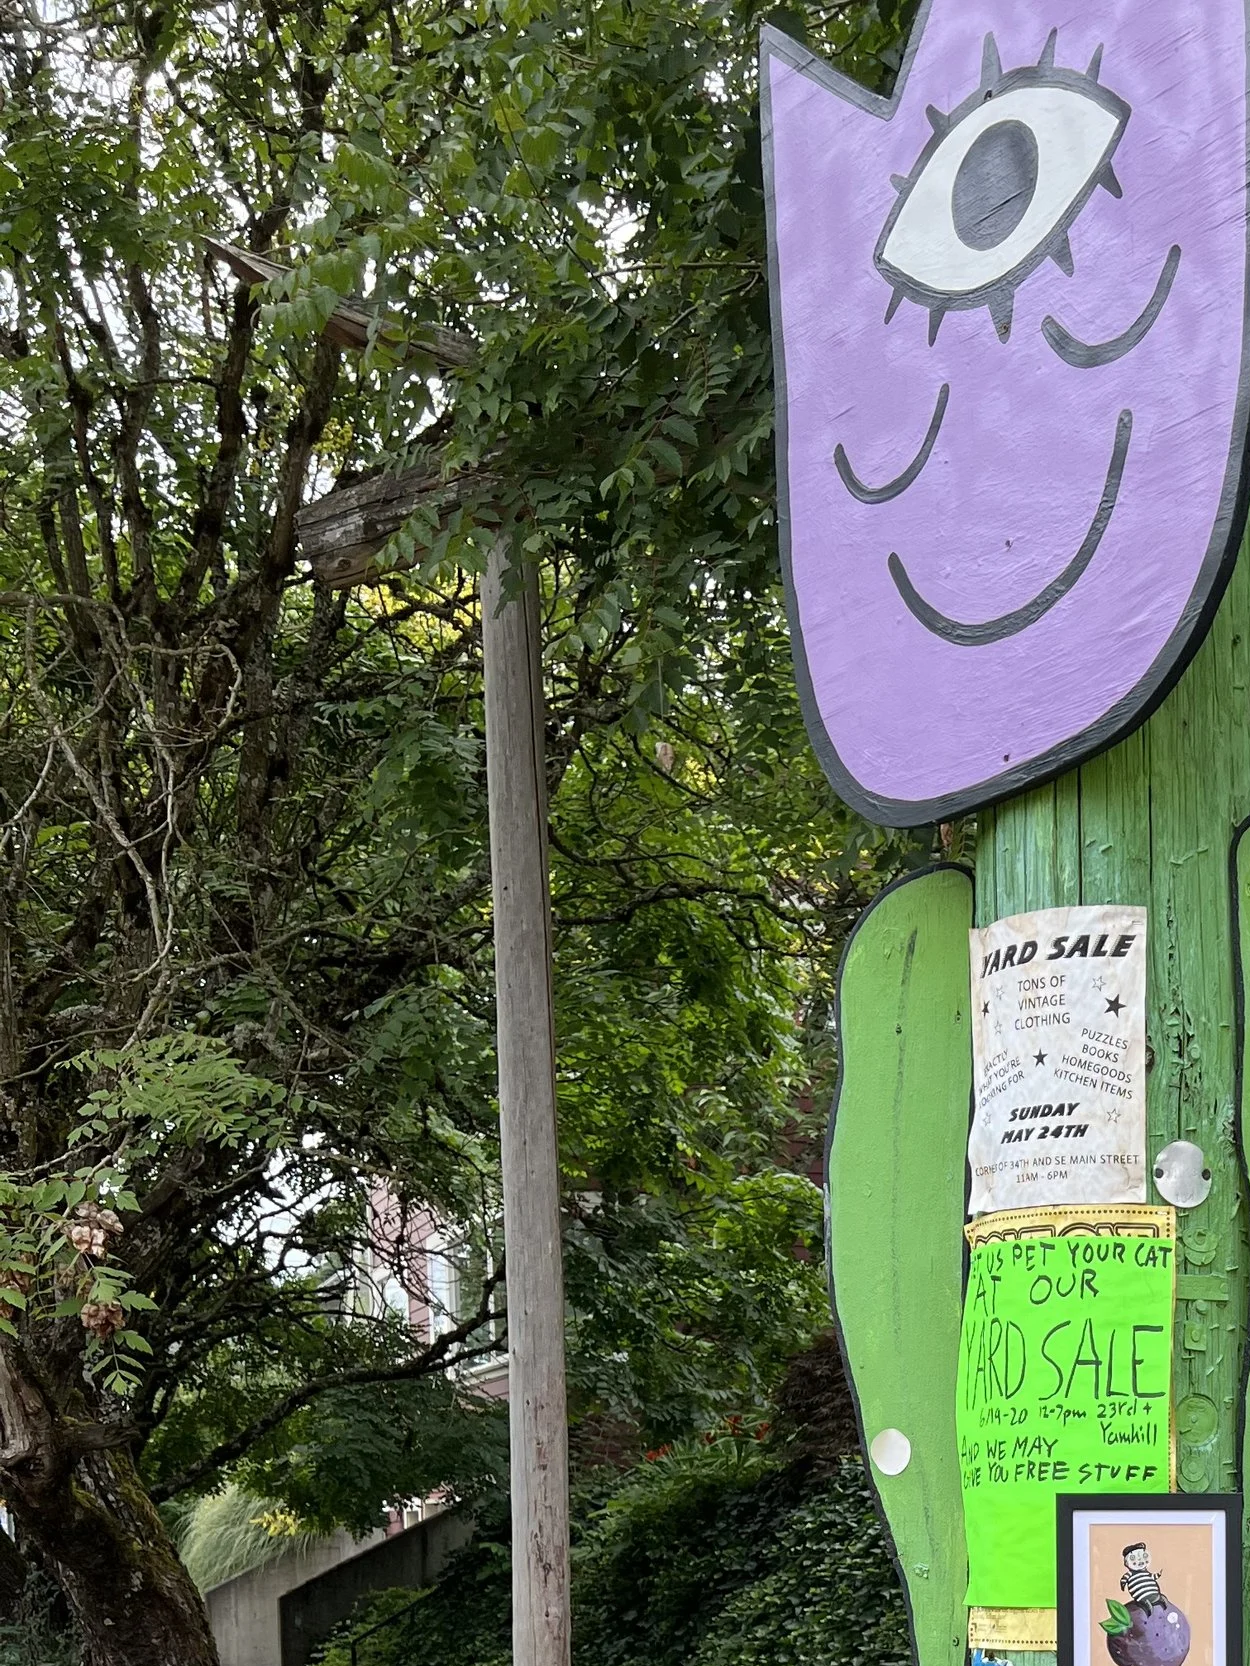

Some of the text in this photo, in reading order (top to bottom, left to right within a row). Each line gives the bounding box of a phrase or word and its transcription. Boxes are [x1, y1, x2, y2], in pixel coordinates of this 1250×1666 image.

[980, 934, 1136, 978] YARD SALE
[1018, 974, 1066, 992] TONS OF
[1018, 994, 1066, 1011] VINTAGE
[1014, 1012, 1071, 1031] CLOTHING
[1081, 1027, 1129, 1050] PUZZLES
[1082, 1044, 1119, 1063] BOOKS
[1008, 1070, 1024, 1085] FOR
[1061, 1054, 1132, 1084] HOMEGOODS
[1054, 1068, 1133, 1100] KITCHEN ITEMS
[1008, 1102, 1080, 1122] SUNDAY
[1000, 1124, 1090, 1144] MAY 24TH
[1032, 1156, 1052, 1166] AND
[1054, 1156, 1066, 1165] SE
[1070, 1155, 1097, 1164] MAIN
[1100, 1154, 1140, 1164] STREET
[1016, 1170, 1068, 1184] 11AM 6PM
[986, 1248, 1004, 1275] US
[1012, 1242, 1056, 1271] PET
[1067, 1240, 1126, 1268] YOUR
[1134, 1242, 1173, 1268] CAT
[974, 1268, 1100, 1316] AT OUR
[966, 1317, 1166, 1412] YARD SALE
[1142, 1402, 1152, 1416] +
[1100, 1421, 1158, 1446] Yamhill
[986, 1439, 1007, 1460] WE
[1012, 1436, 1059, 1459] MAY
[988, 1462, 1009, 1484] YOU
[1014, 1460, 1070, 1483] FREE
[1078, 1462, 1158, 1485] STUFF
